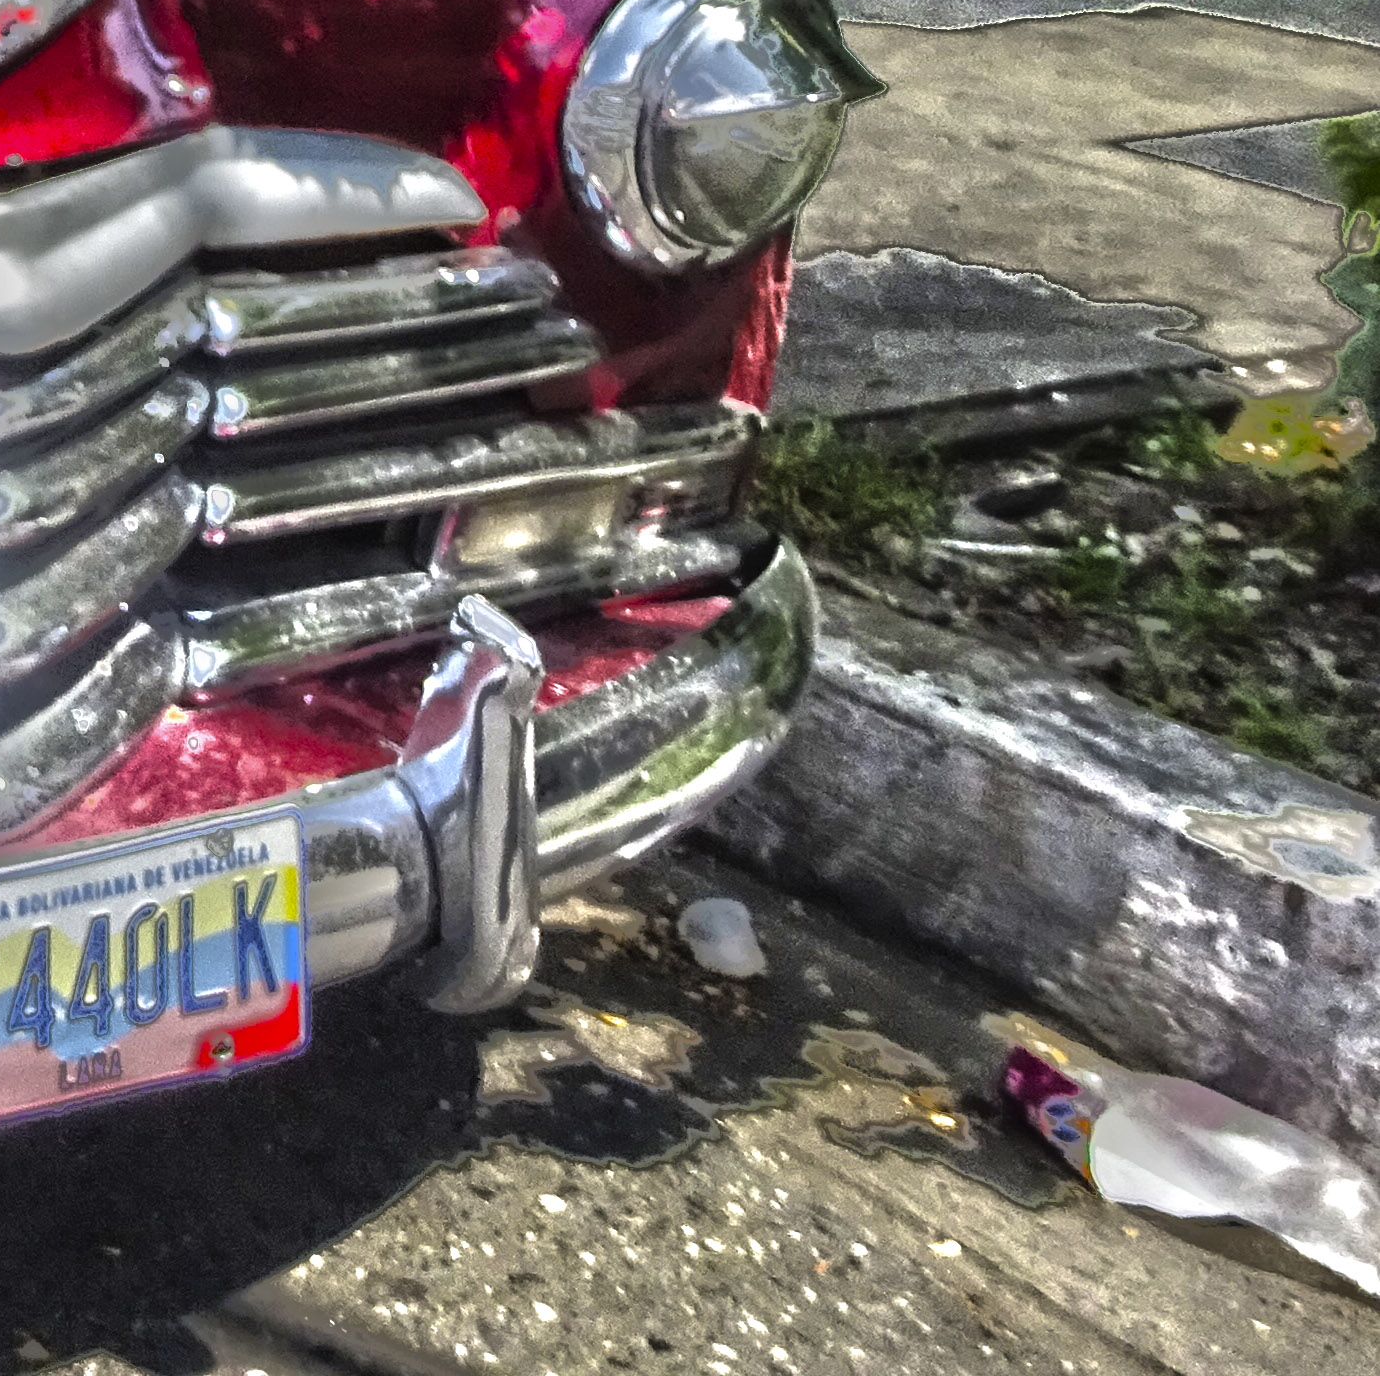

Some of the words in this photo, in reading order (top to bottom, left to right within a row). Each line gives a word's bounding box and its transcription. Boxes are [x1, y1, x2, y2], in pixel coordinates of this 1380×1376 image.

[16, 872, 138, 917] BOLIVARIANA
[142, 864, 166, 888] DE
[172, 841, 270, 882] VENEZUELA
